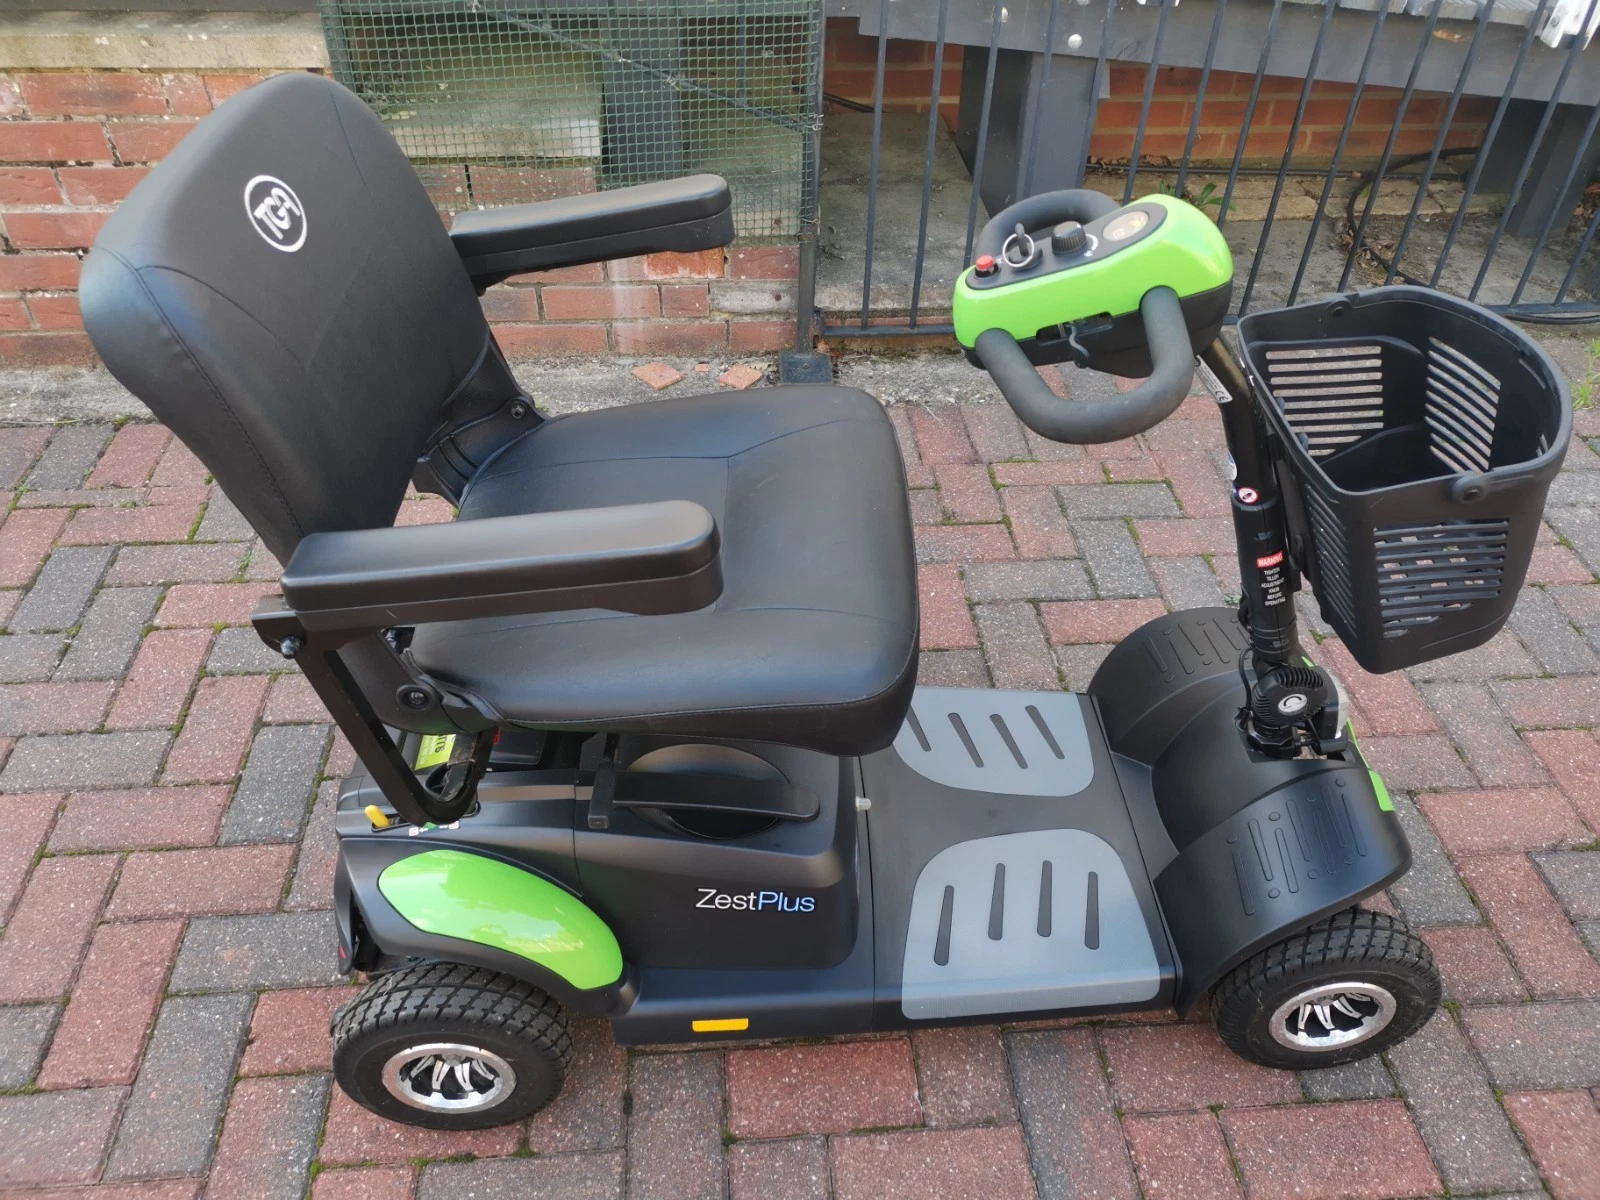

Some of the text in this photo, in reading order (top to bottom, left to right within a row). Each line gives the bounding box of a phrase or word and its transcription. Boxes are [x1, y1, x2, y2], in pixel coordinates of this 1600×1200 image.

[253, 187, 301, 241] TGA
[1258, 552, 1283, 566] WARNING
[1261, 577, 1284, 587] ADJUSTMENT
[1265, 597, 1286, 606] OPERATING
[695, 888, 815, 912] ZestPlus
